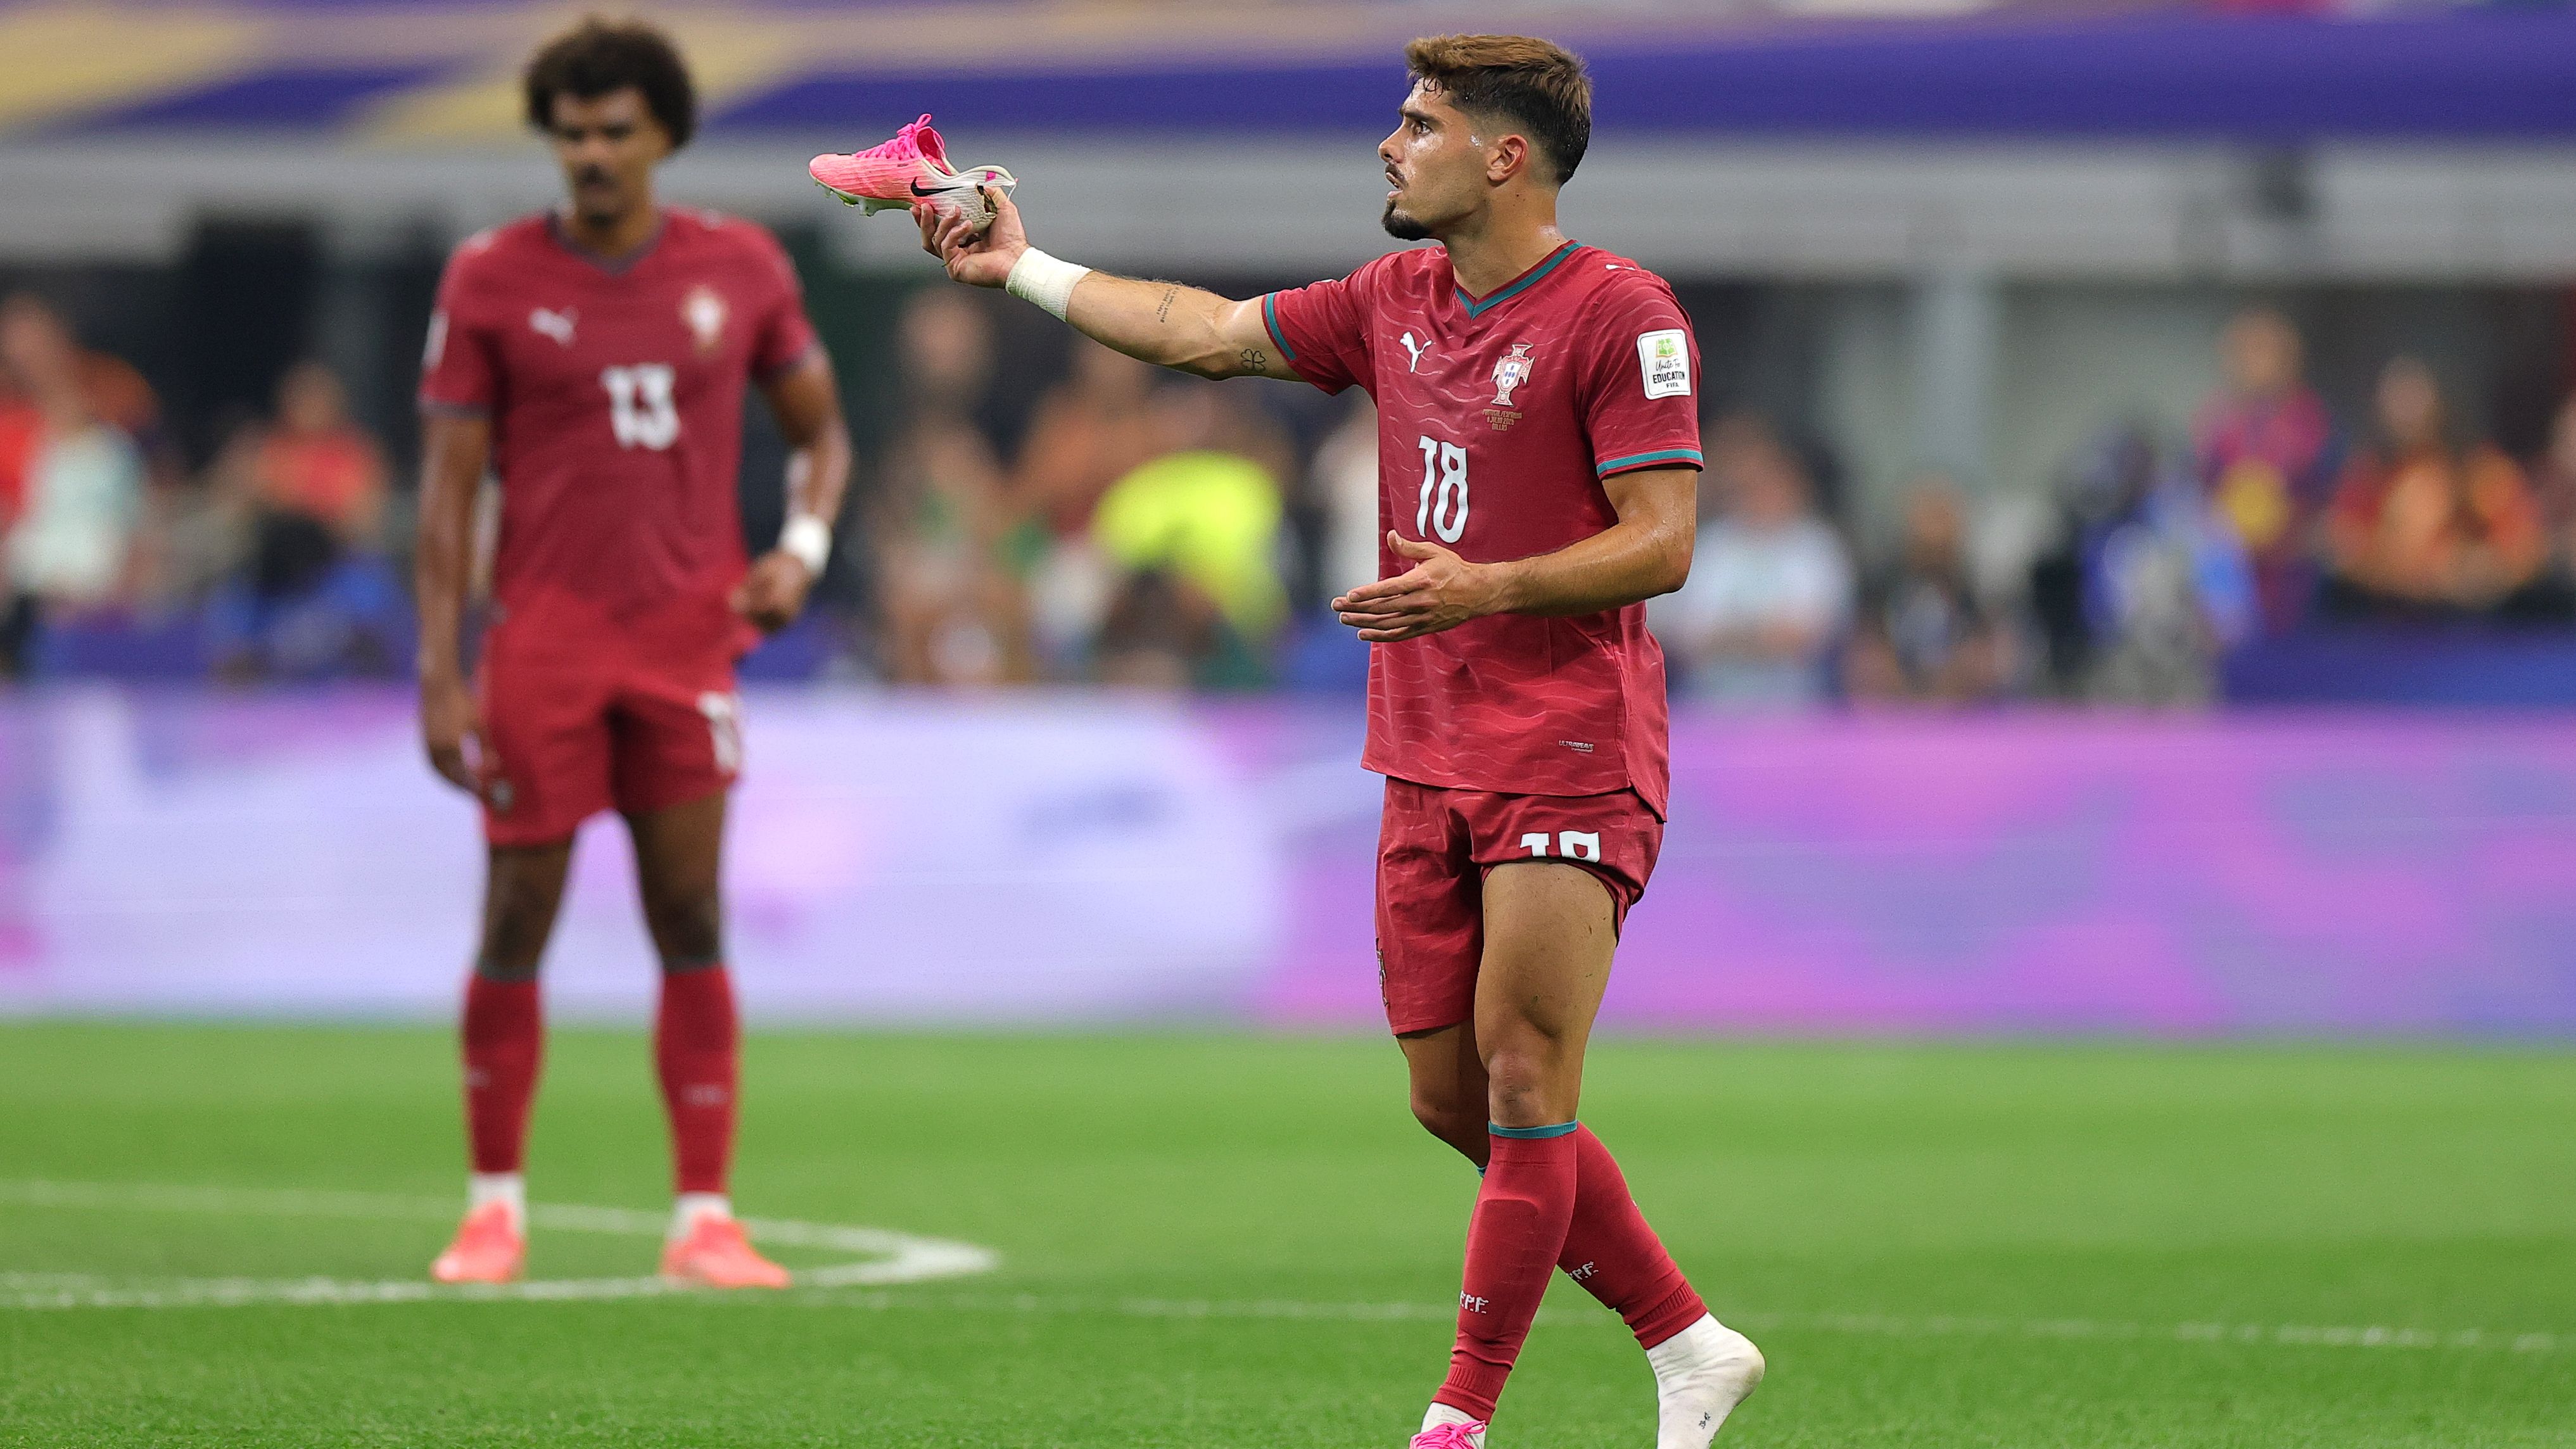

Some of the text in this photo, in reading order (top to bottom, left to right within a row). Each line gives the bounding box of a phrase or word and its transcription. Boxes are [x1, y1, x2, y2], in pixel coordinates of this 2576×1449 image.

[601, 363, 679, 449] 13
[1656, 360, 1673, 372] Unite
[1416, 435, 1469, 543] 18
